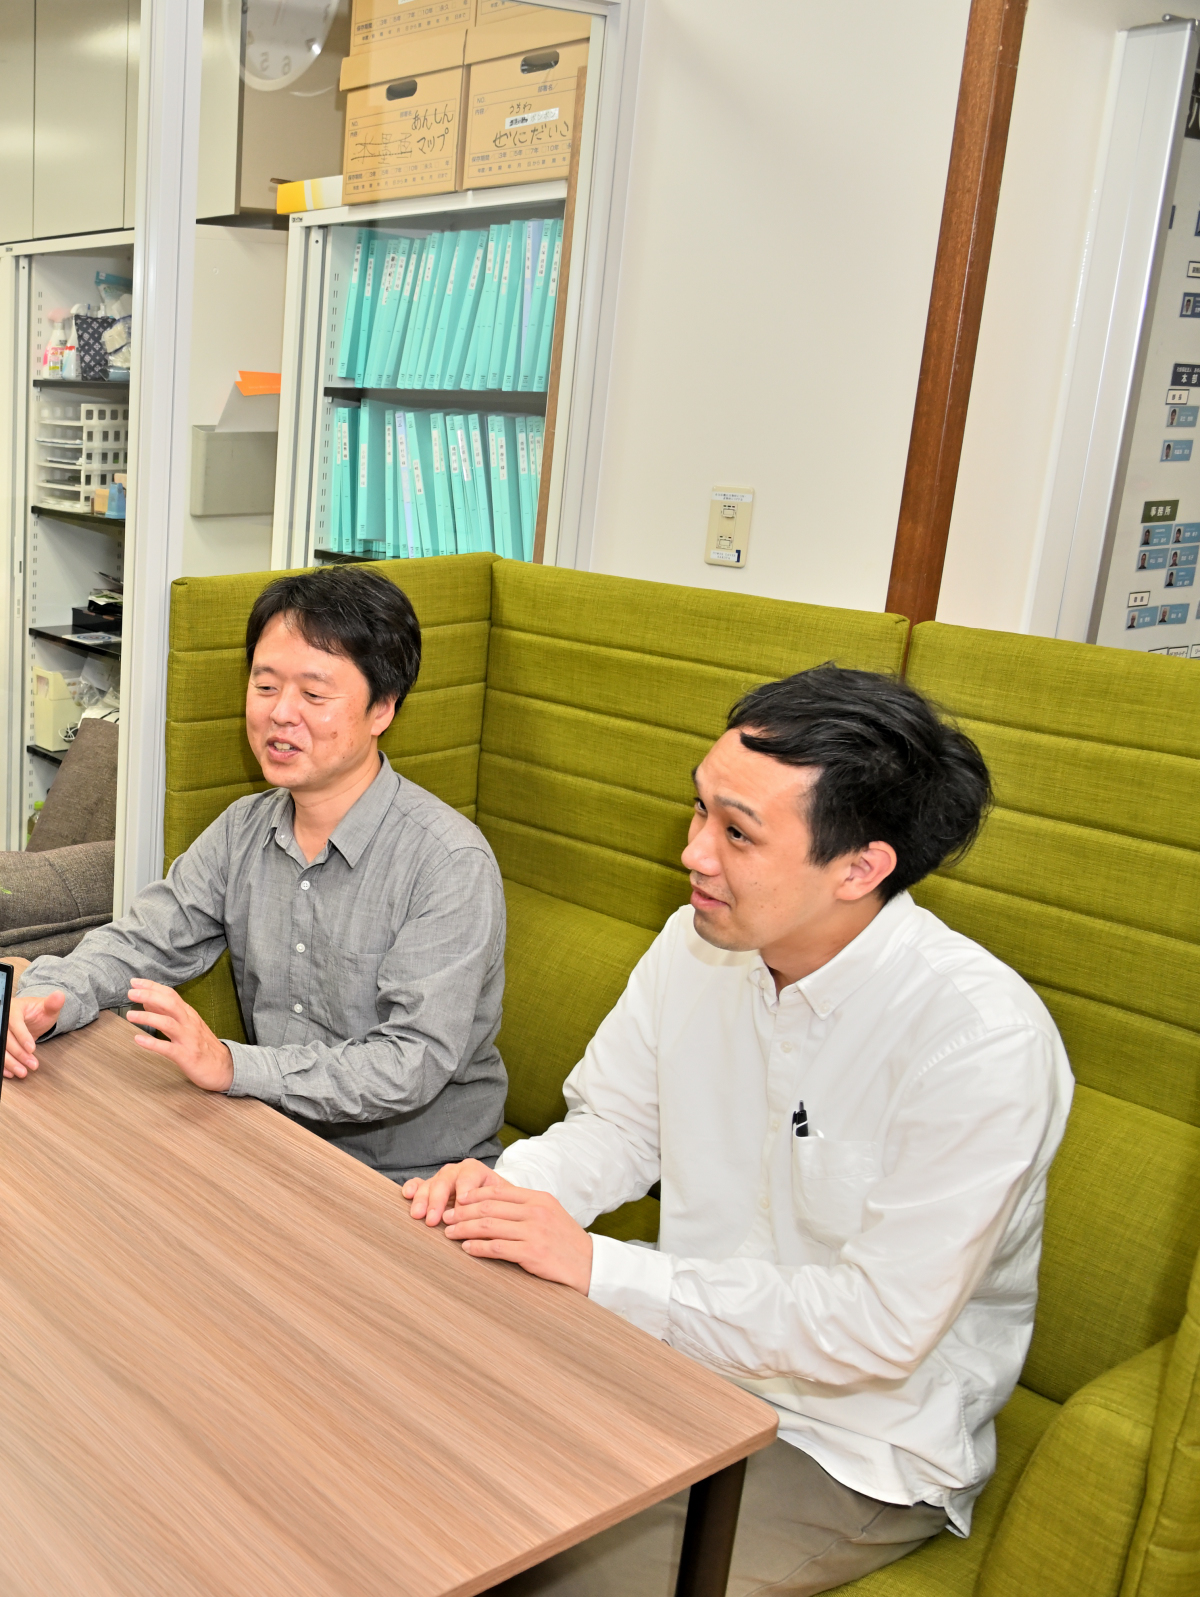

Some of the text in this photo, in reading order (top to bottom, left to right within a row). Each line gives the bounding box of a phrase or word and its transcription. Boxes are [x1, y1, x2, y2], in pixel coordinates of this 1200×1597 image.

[412, 104, 454, 131] あんしん
[417, 127, 449, 154] マップ
[1150, 505, 1172, 517] 事務所
